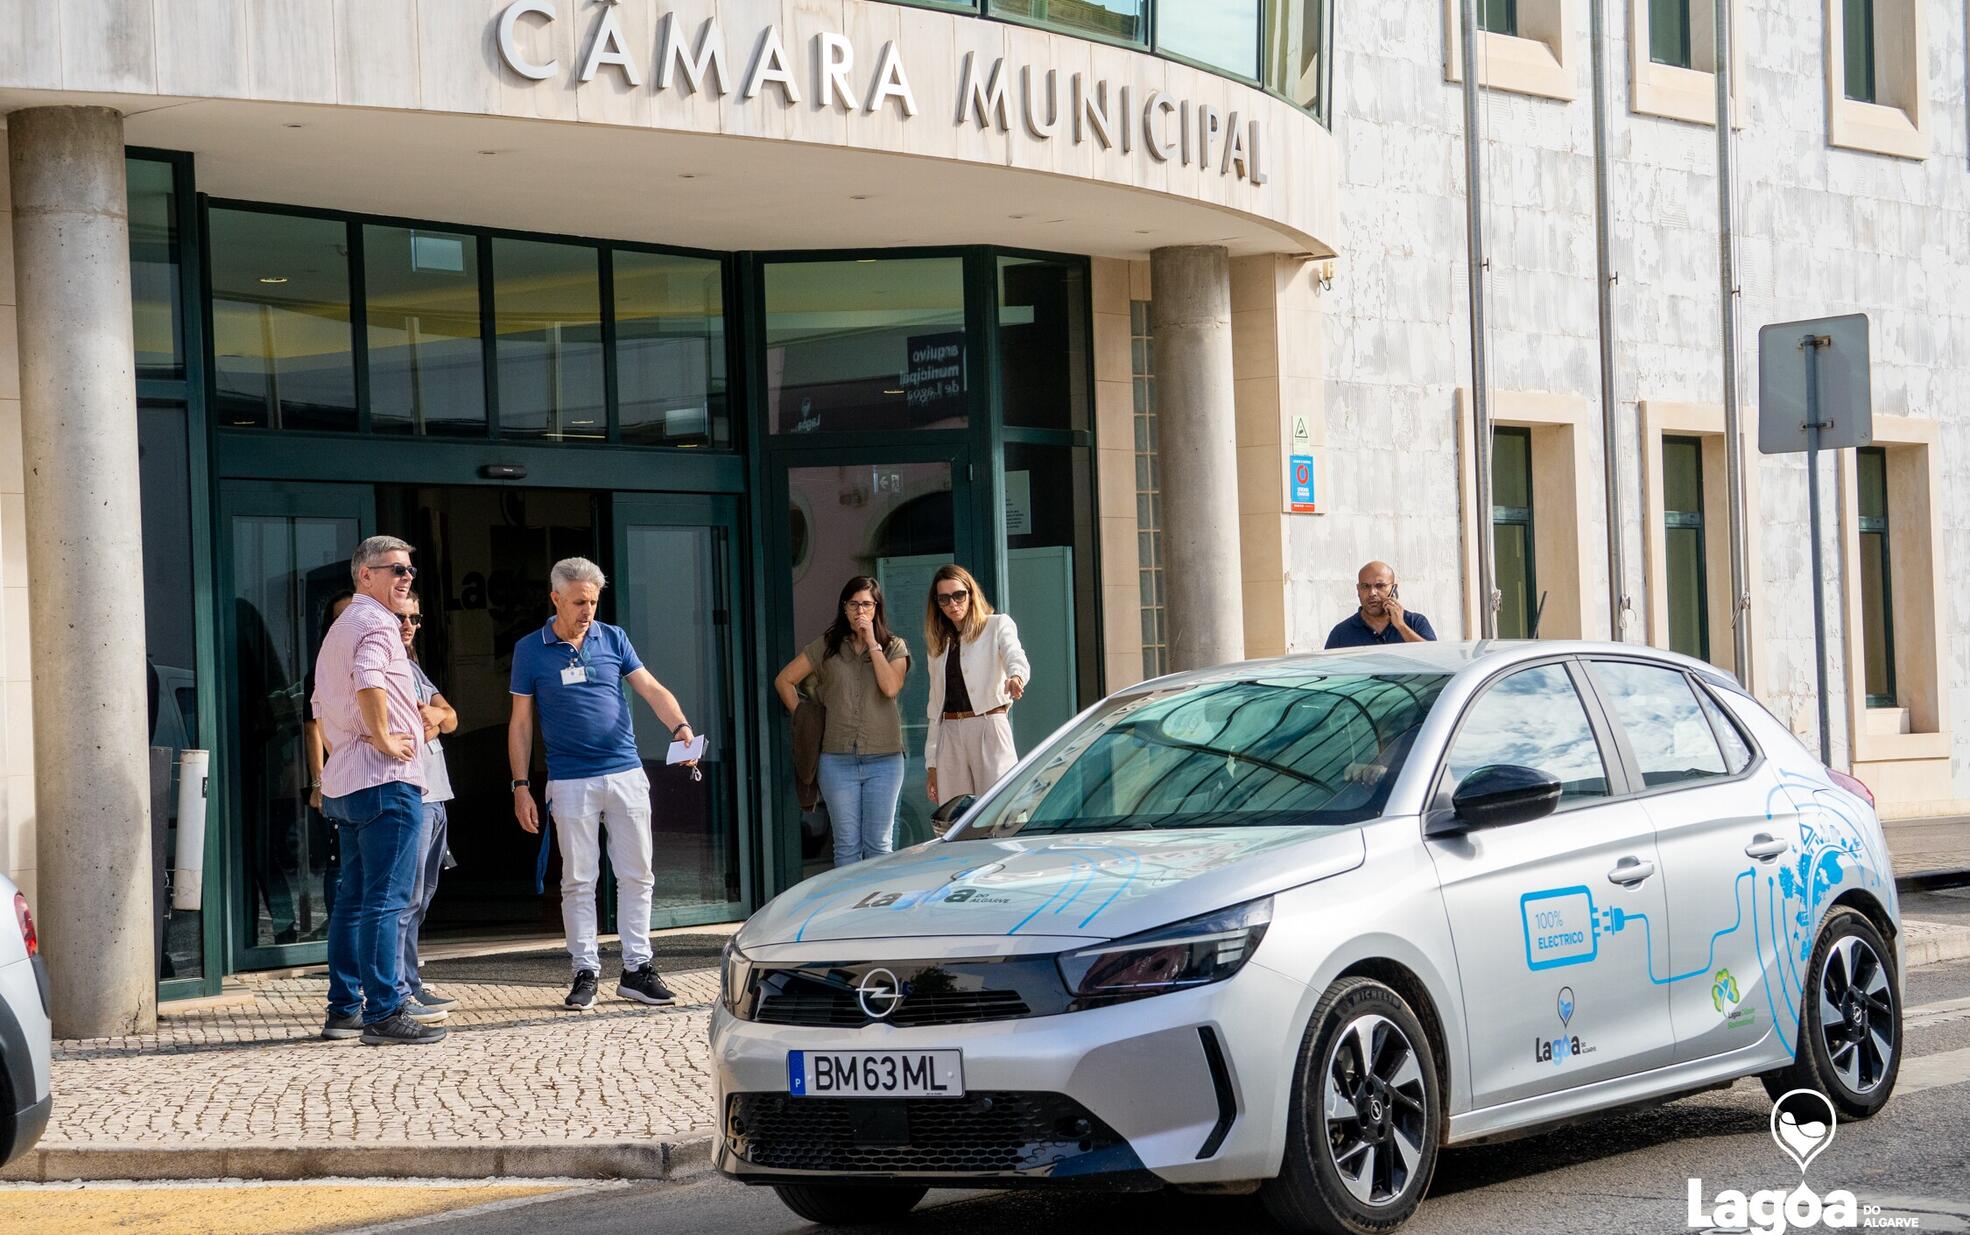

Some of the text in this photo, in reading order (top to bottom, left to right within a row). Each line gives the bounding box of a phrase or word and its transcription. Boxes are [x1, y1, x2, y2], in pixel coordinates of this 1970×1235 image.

[496, 0, 1268, 185] CÂMARA MUNICIPAL
[1535, 910, 1563, 930] 100%
[1535, 1033, 1581, 1065] Lagoa
[795, 1078, 801, 1088] P
